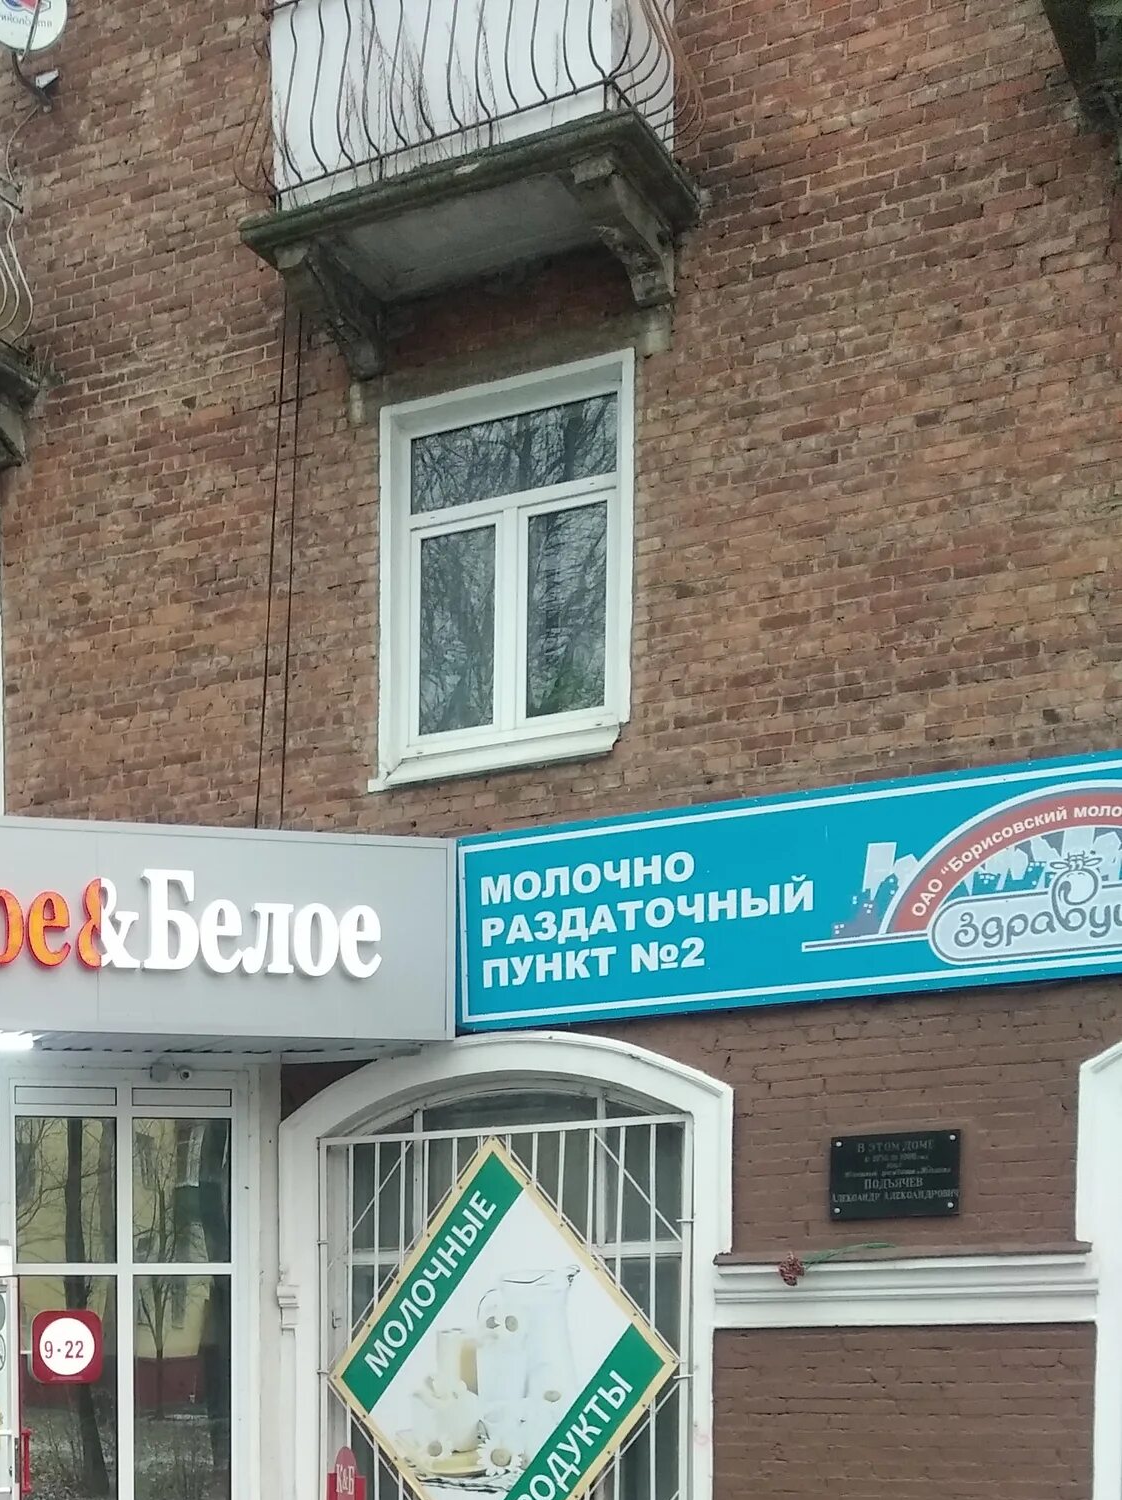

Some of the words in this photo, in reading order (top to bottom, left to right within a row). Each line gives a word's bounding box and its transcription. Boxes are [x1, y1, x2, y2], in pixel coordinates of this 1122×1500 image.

[480, 851, 696, 906] МОЛОЧНО
[911, 878, 943, 917] ОАО
[481, 876, 815, 947] РАЗДАТОЧНЫЙ
[482, 947, 617, 990] ПУНКТ
[631, 936, 706, 974] №2
[857, 1143, 866, 1153] В
[868, 1142, 900, 1152] ЭТОМ
[902, 1139, 935, 1152] ДОМЕ
[363, 1190, 497, 1379] МОЛОЧНЫЕ
[336, 1463, 355, 1495] К&Б
